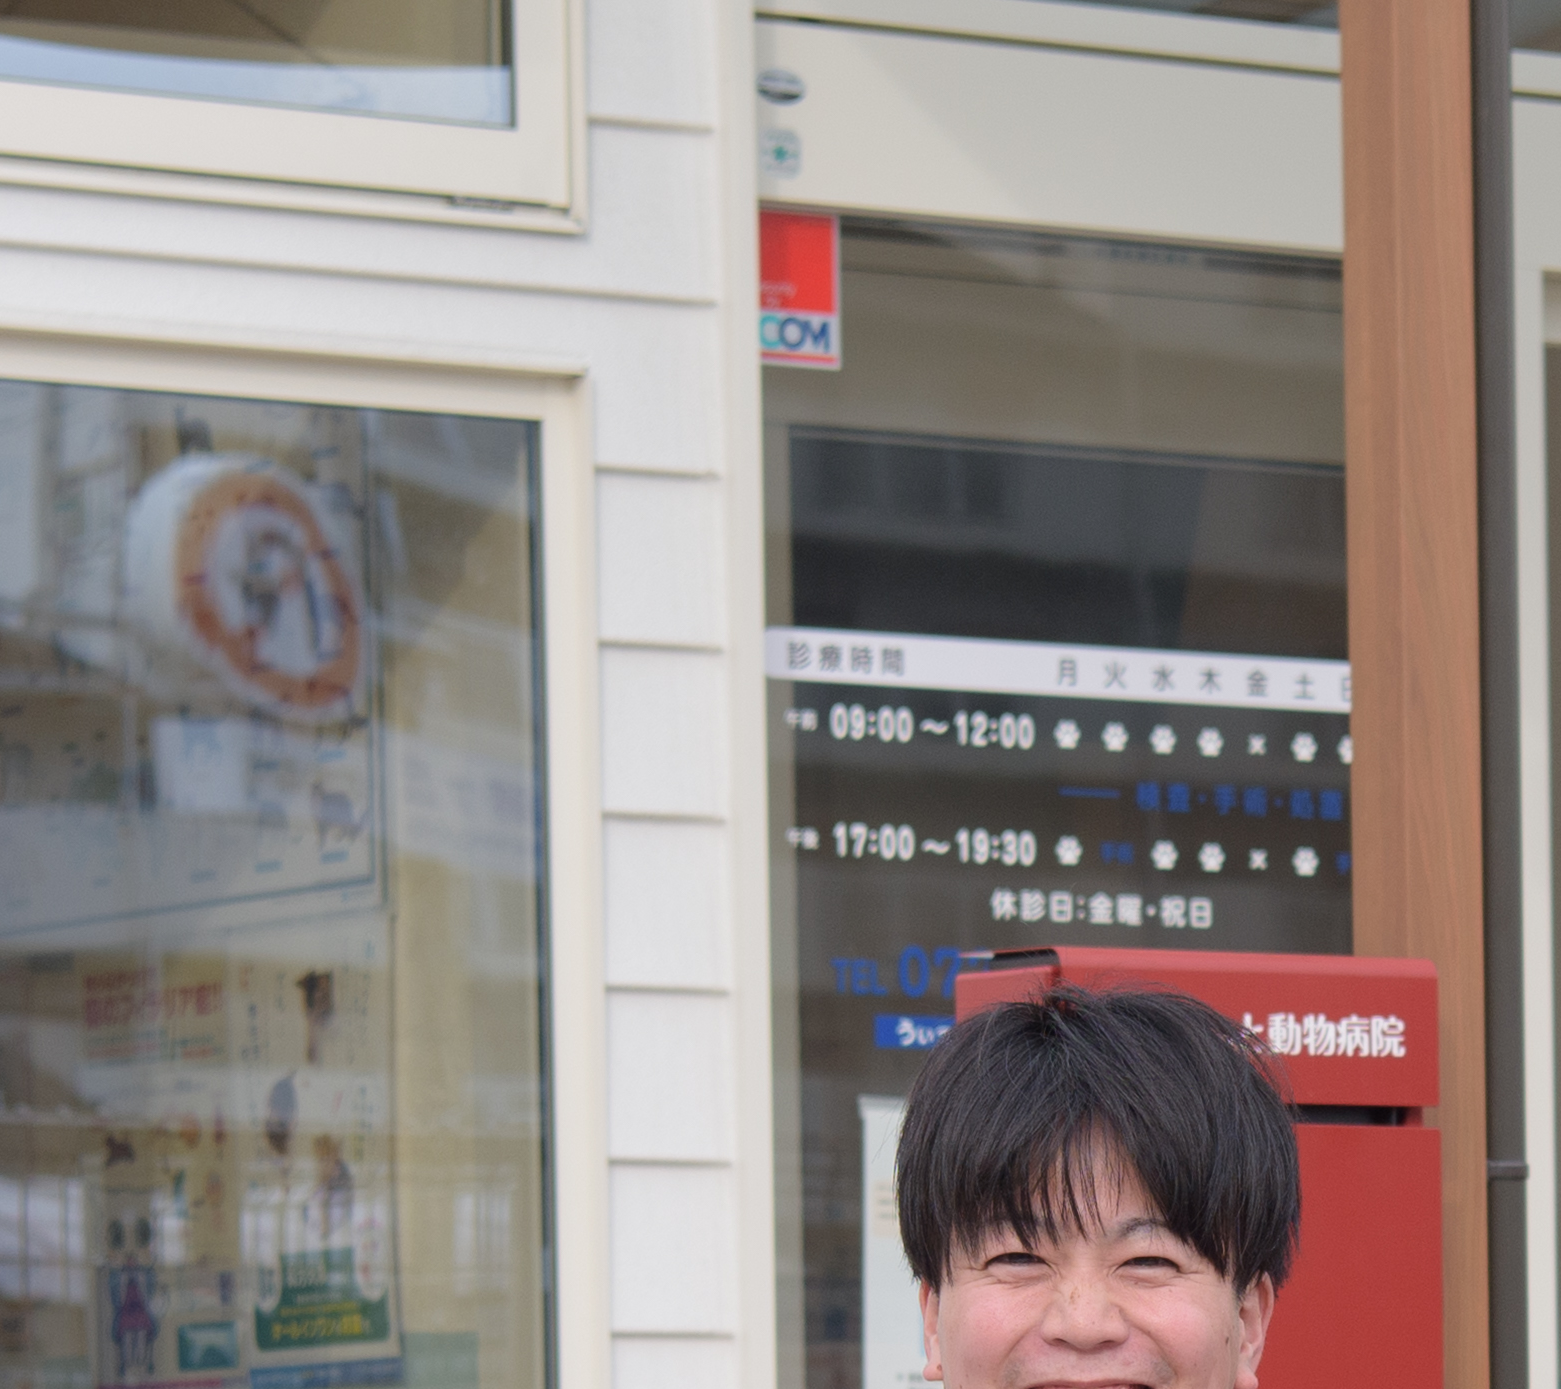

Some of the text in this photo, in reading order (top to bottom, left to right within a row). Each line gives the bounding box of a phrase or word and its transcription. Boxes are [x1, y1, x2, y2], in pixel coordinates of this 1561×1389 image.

[760, 314, 830, 354] COM
[787, 641, 905, 676] 診療時間
[1057, 658, 1078, 688] 月
[1103, 662, 1127, 690] 火
[1152, 664, 1175, 692] 水
[1199, 668, 1222, 694] 木
[1247, 670, 1268, 697] 金
[1294, 673, 1315, 700] 土
[830, 957, 887, 996] TEL
